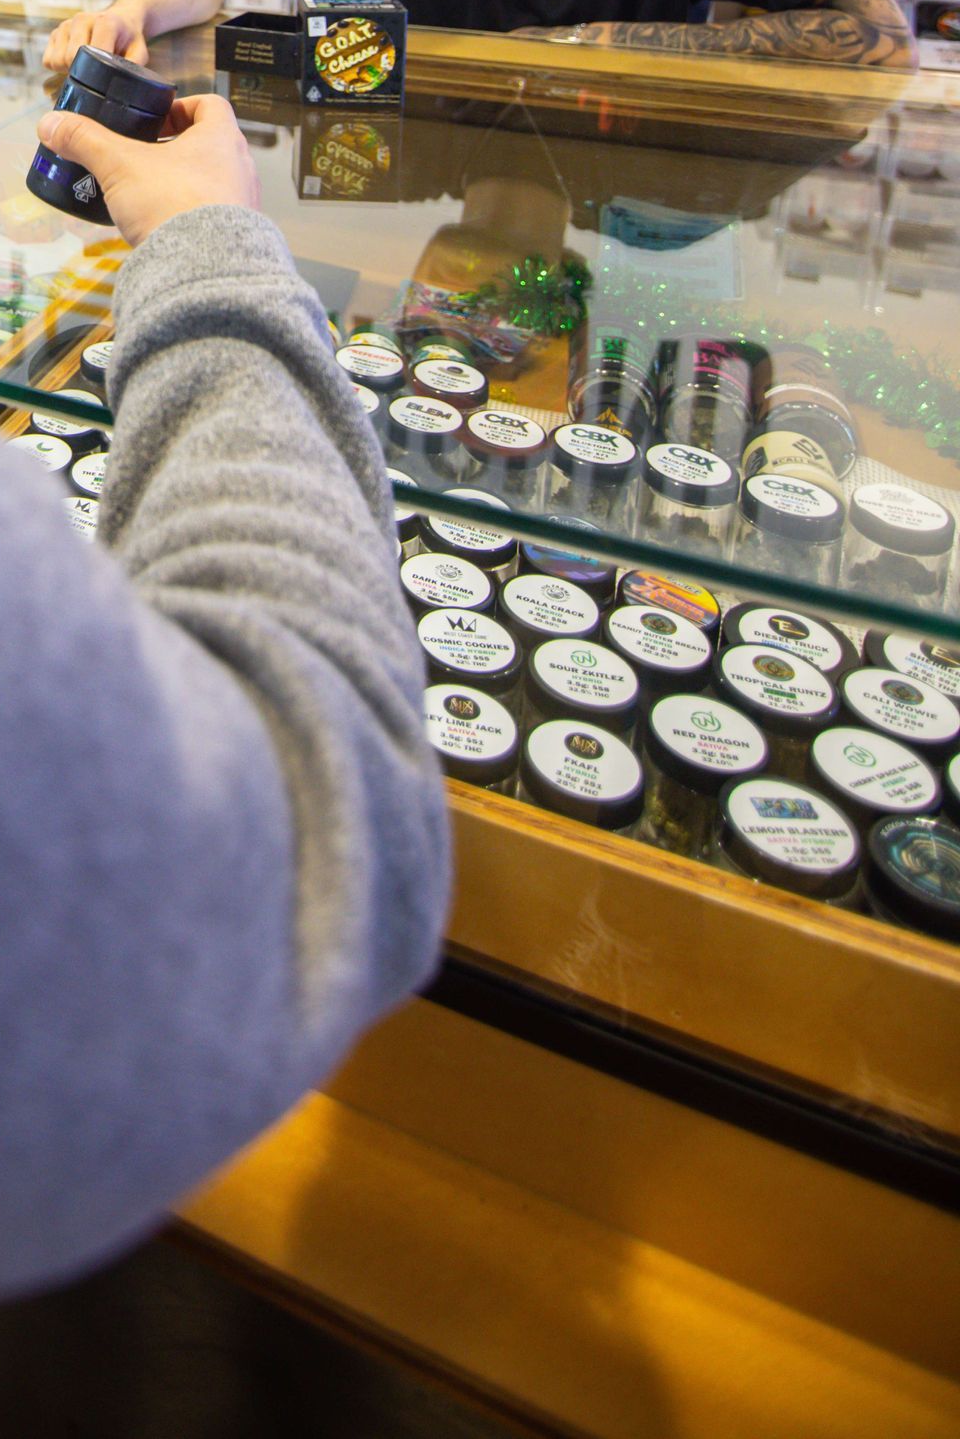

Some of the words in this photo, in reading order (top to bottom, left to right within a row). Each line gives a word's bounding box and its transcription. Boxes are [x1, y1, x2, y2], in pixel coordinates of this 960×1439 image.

[328, 44, 380, 74] Cheese
[75, 190, 89, 203] CA
[485, 413, 529, 433] CBX
[500, 428, 528, 437] CRUSH
[571, 427, 620, 448] CBX
[668, 447, 718, 472] CBX
[762, 479, 819, 502] CBX
[469, 531, 496, 542] HYBRID
[479, 528, 504, 540] CURE
[411, 573, 438, 585] DARK
[440, 581, 474, 596] KARMA
[412, 579, 438, 590] SATIVA
[441, 588, 470, 599] HYBRID
[516, 594, 549, 608] KOALA
[551, 604, 585, 618] CRACK
[534, 606, 564, 617] HYBRID
[423, 635, 463, 646] COSMIC
[465, 641, 510, 651] COOKIES
[611, 621, 642, 634] PEANUT
[643, 631, 673, 643] BUTTER
[675, 640, 707, 654] BREATH
[642, 636, 673, 648] HYBRID
[754, 630, 790, 644] DIESEL
[794, 641, 830, 653] TRUCK
[439, 645, 466, 653] INDICA
[791, 646, 824, 658] HYBRID
[549, 662, 579, 673] SOUR
[582, 669, 624, 682] ZKITLEZ
[571, 674, 603, 684] HYBRID
[730, 673, 784, 691] TROPICAL
[788, 686, 827, 698] RUNTZ
[937, 682, 957, 694] THC
[863, 691, 890, 704] CALI
[893, 701, 938, 720] WOWIE
[881, 705, 918, 719] HYBRID
[446, 718, 473, 729] LIME
[475, 724, 502, 735] JACK
[447, 725, 477, 737] SATIVA
[672, 728, 697, 739] RED
[699, 733, 750, 749] DRAGON
[464, 744, 483, 753] THC
[697, 741, 729, 752] SATIVA
[563, 757, 600, 774] FKAFL
[563, 765, 598, 780] HYBRID
[849, 776, 876, 789] CHERRY
[579, 786, 599, 797] THC
[741, 826, 785, 834] LEMON
[786, 826, 849, 838] BLASTERS
